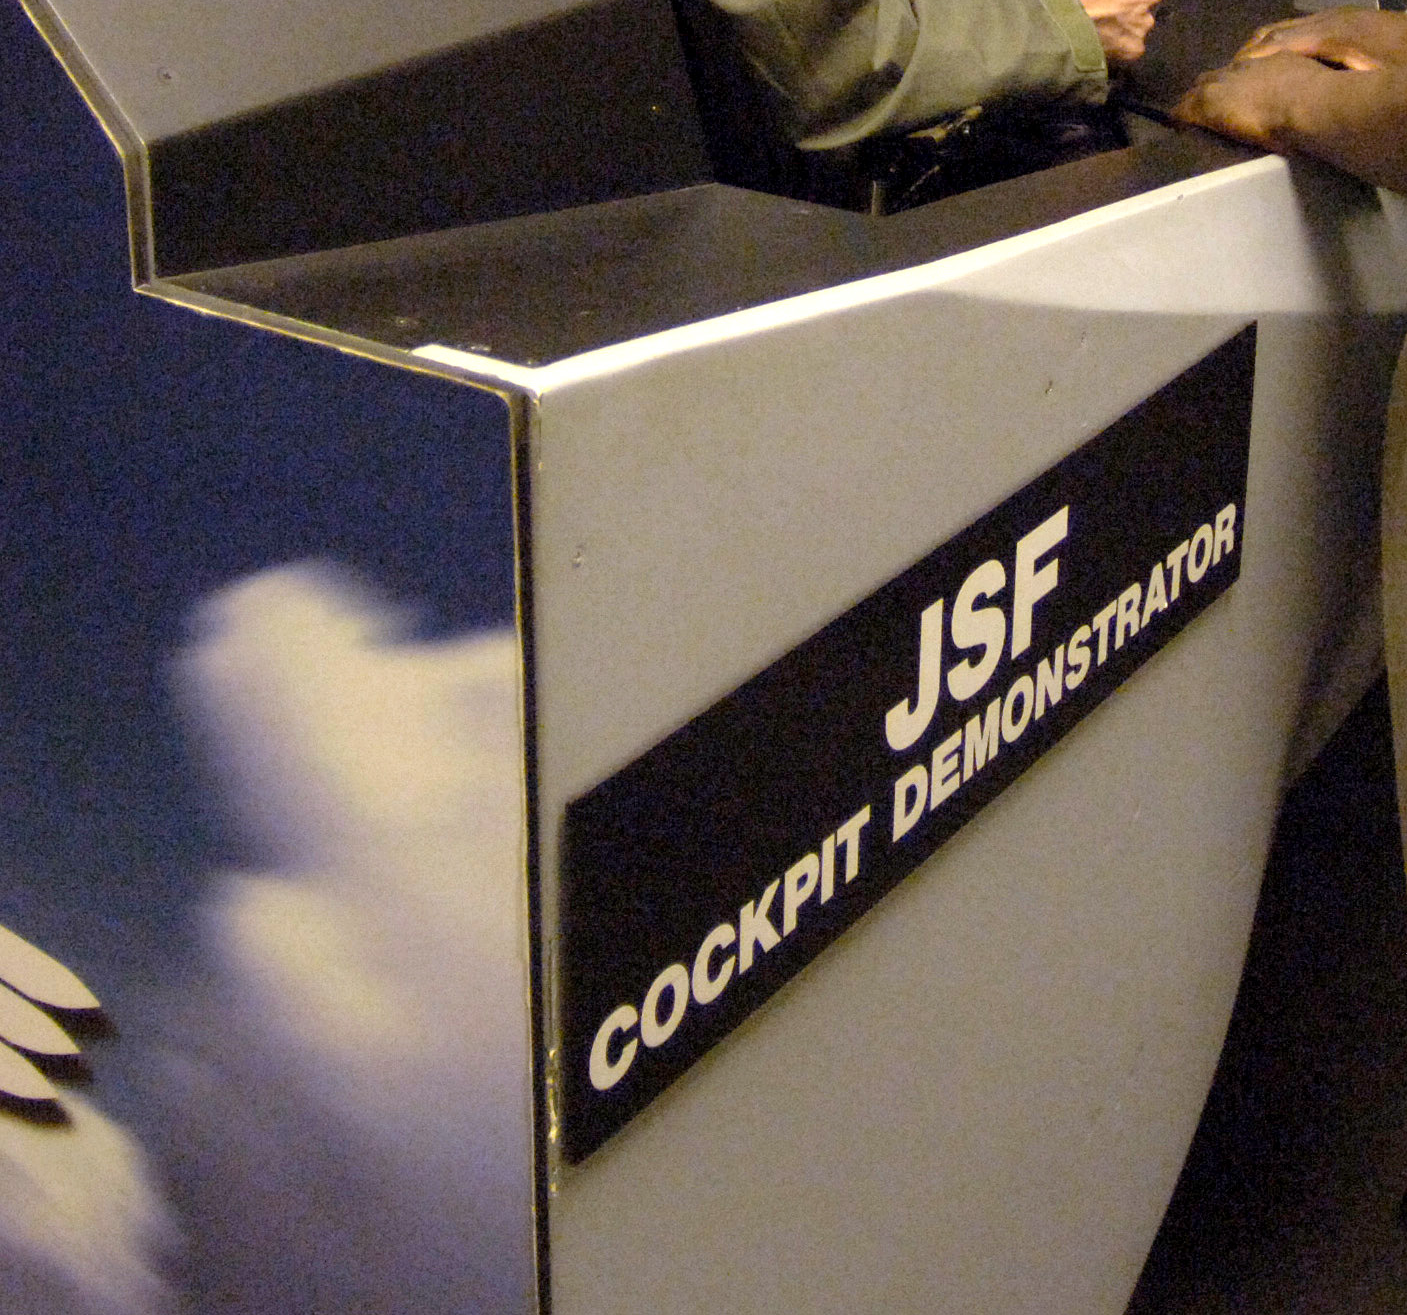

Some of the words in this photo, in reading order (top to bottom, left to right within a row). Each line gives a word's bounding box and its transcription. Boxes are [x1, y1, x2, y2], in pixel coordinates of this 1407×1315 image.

[589, 804, 871, 1091] COCKPIT
[892, 502, 1237, 844] DEMONSTRATOR
[885, 505, 1069, 751] JSF
